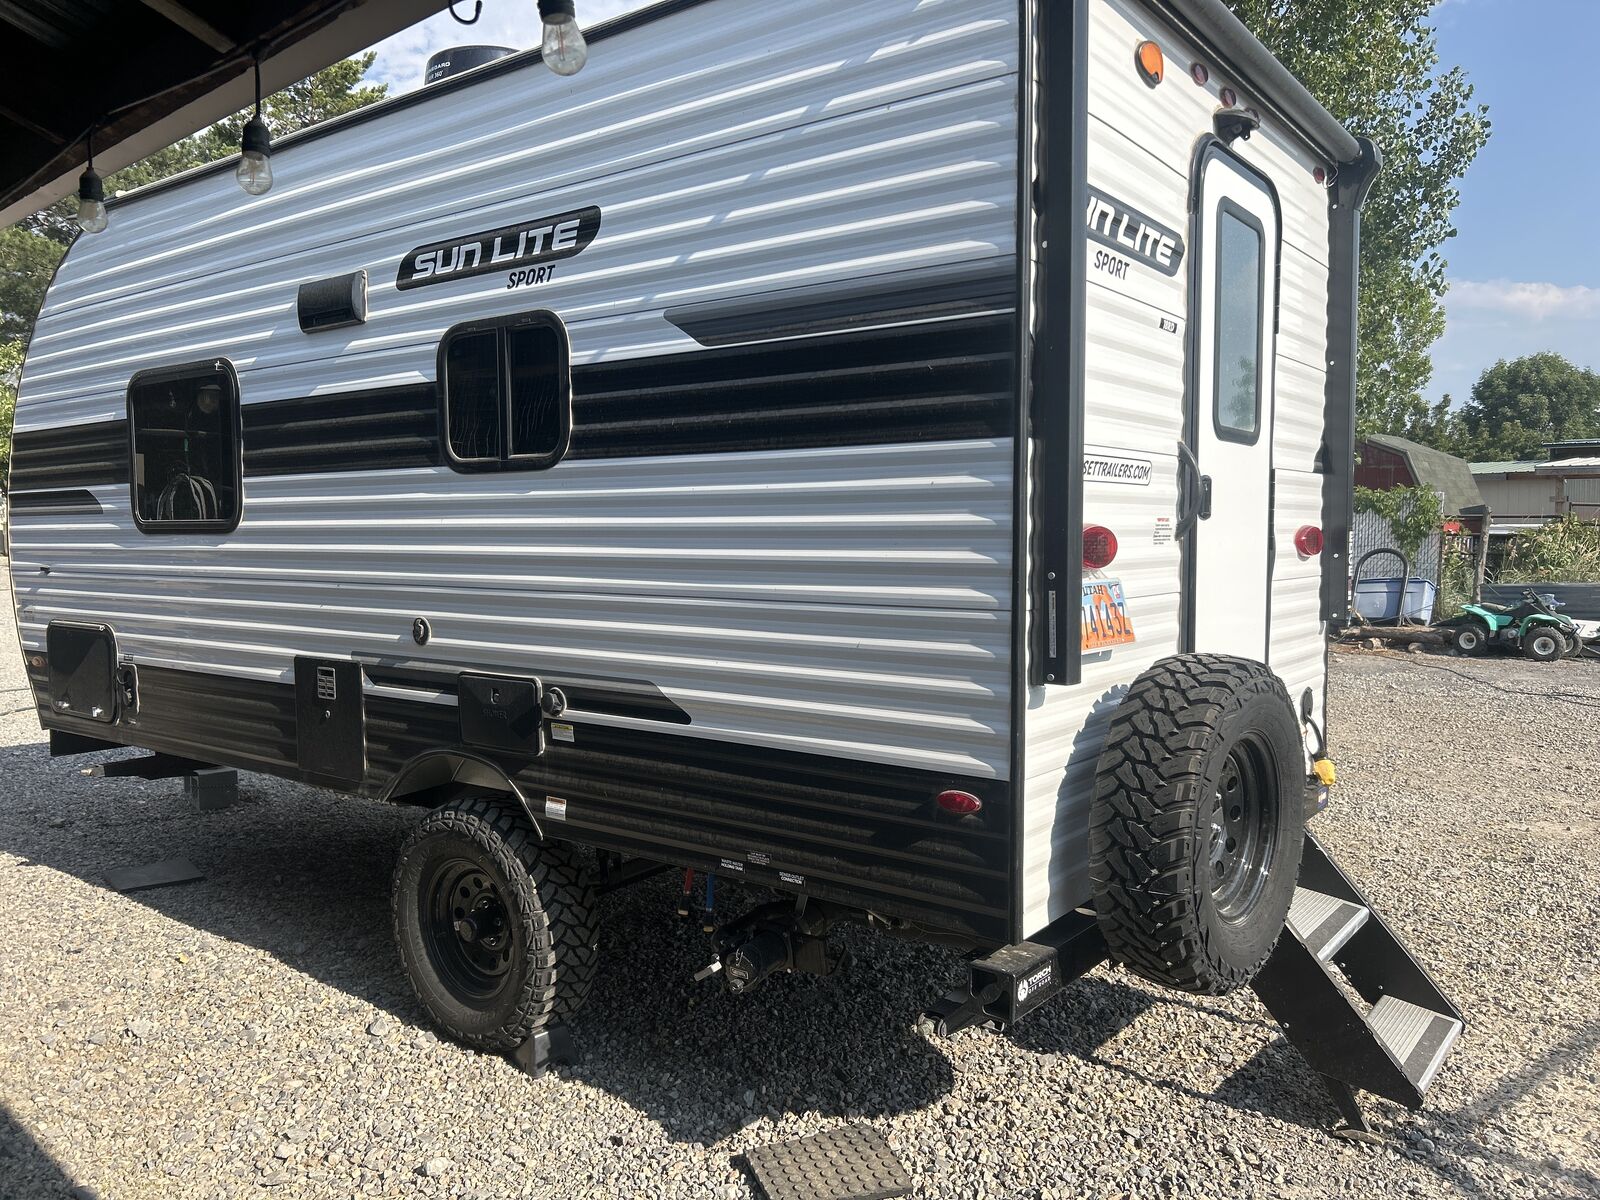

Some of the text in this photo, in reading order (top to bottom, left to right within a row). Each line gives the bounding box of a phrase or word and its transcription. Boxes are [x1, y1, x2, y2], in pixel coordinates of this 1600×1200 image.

[412, 219, 580, 280] SUN LITE
[1117, 213, 1175, 267] LITE
[507, 264, 555, 290] SPORT
[1094, 250, 1130, 280] SPORT
[1028, 965, 1051, 985] TORCH
